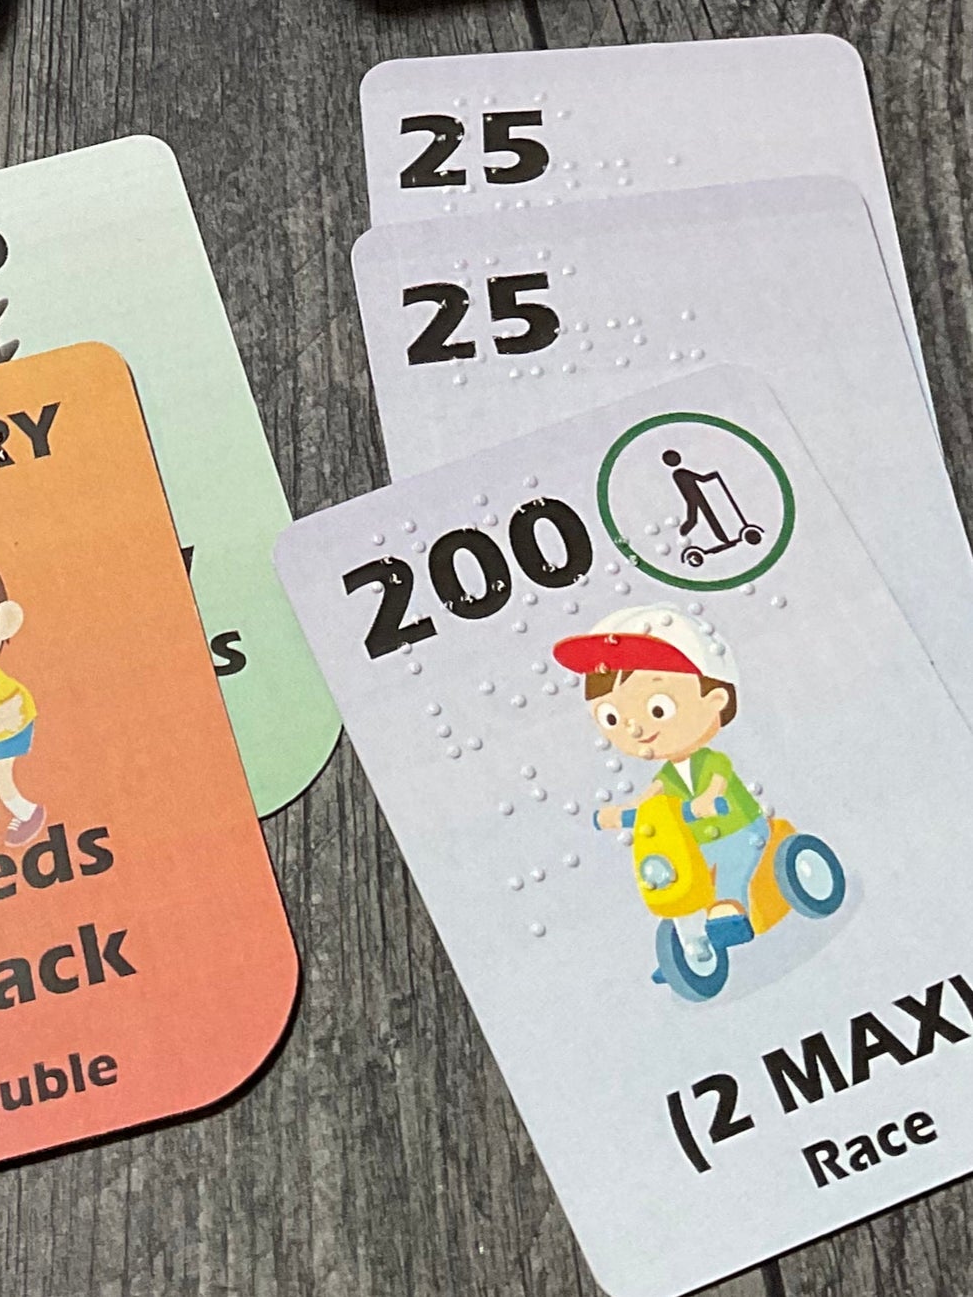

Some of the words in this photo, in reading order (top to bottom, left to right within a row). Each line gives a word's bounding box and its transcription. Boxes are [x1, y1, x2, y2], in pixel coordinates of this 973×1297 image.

[399, 109, 550, 189] 25
[402, 271, 561, 367] 25
[342, 497, 594, 661] 200
[666, 1072, 755, 1173] (2
[801, 1110, 938, 1188] Race
